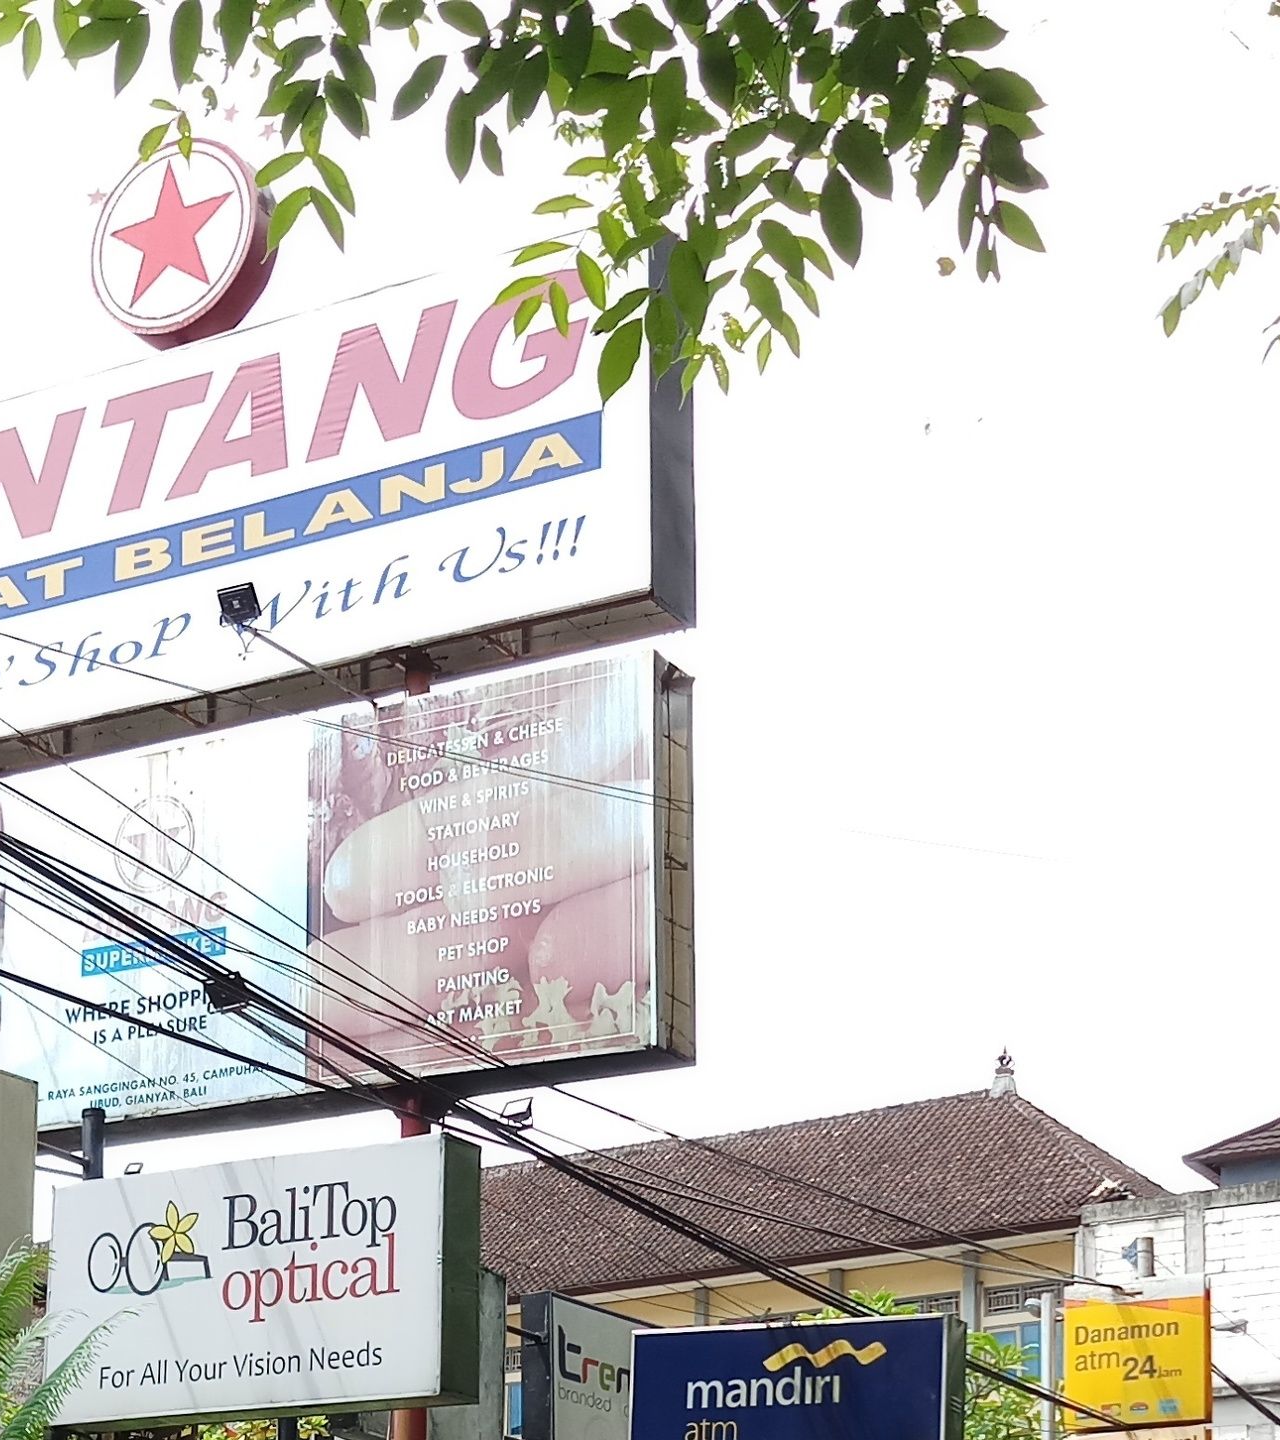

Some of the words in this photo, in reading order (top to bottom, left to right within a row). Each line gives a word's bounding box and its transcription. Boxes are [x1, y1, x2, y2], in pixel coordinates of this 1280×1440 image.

[114, 430, 584, 581] BELANJA
[438, 515, 586, 583] Us!!!
[387, 733, 489, 766] DELICATESSEN
[493, 731, 505, 745] &
[508, 718, 563, 742] CHEESE
[400, 770, 444, 792] FOOD
[447, 768, 458, 783] &
[463, 750, 549, 779] BEVERAGES
[420, 795, 457, 814] WINE
[461, 793, 471, 807] &
[476, 782, 529, 804] SPIRITS
[427, 811, 520, 841] STATIONARY
[427, 842, 520, 871] HOUSEHOLD
[395, 885, 443, 907] TOOLS
[448, 884, 458, 897] &
[463, 866, 554, 895] ELECTRONIC
[407, 915, 447, 935] BABY
[451, 907, 498, 928] NEEDS
[502, 899, 541, 919] TOYS
[83, 928, 226, 972] SUPERKET
[438, 944, 463, 962] PET
[468, 937, 509, 958] SHOP
[437, 968, 510, 993] PAINTING
[65, 999, 130, 1024] WHERE
[136, 989, 207, 1015] SHOPPI
[425, 1010, 455, 1029] ART
[459, 1000, 523, 1023] MARKET
[94, 1030, 106, 1045] IS
[112, 1031, 123, 1043] A
[128, 1015, 207, 1040] PLEASURE
[48, 1089, 75, 1101] RAYA
[79, 1078, 156, 1095] SANGGINGAN
[183, 1086, 207, 1099] BALI
[222, 1233, 400, 1324] optical
[1074, 1321, 1180, 1346] Danamon
[99, 1366, 135, 1390] For
[140, 1359, 168, 1385] All
[176, 1357, 227, 1383] Your
[233, 1351, 301, 1377] Vision
[309, 1341, 383, 1371] Needs
[1075, 1350, 1120, 1371] atm
[1122, 1355, 1157, 1382] 24
[558, 1382, 612, 1412] branded
